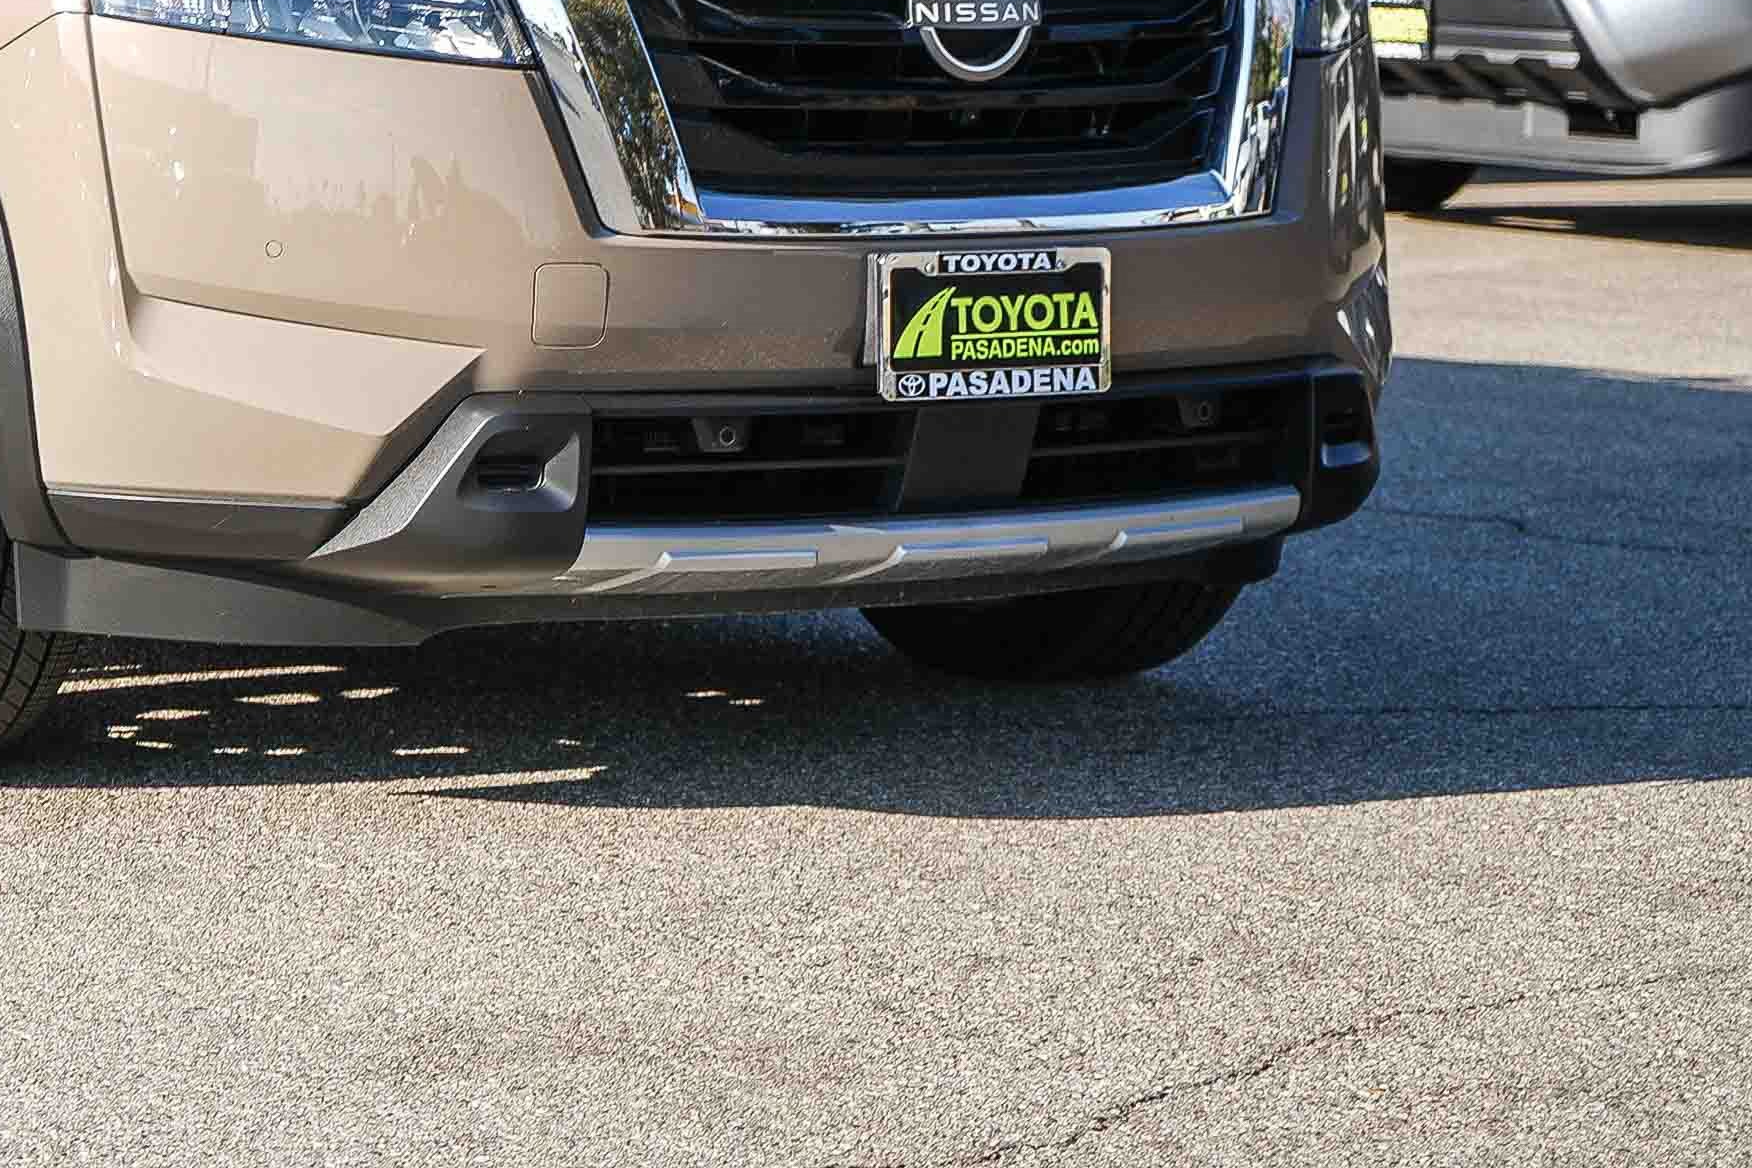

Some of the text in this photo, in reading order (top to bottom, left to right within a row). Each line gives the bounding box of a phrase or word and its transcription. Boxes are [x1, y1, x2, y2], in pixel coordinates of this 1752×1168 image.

[915, 1, 1040, 24] NISSAN
[940, 252, 1051, 273] TOYOTA
[950, 292, 1097, 333] TOYOTA
[951, 337, 1099, 360] PASADENA.com
[928, 366, 1097, 397] PASADENA
